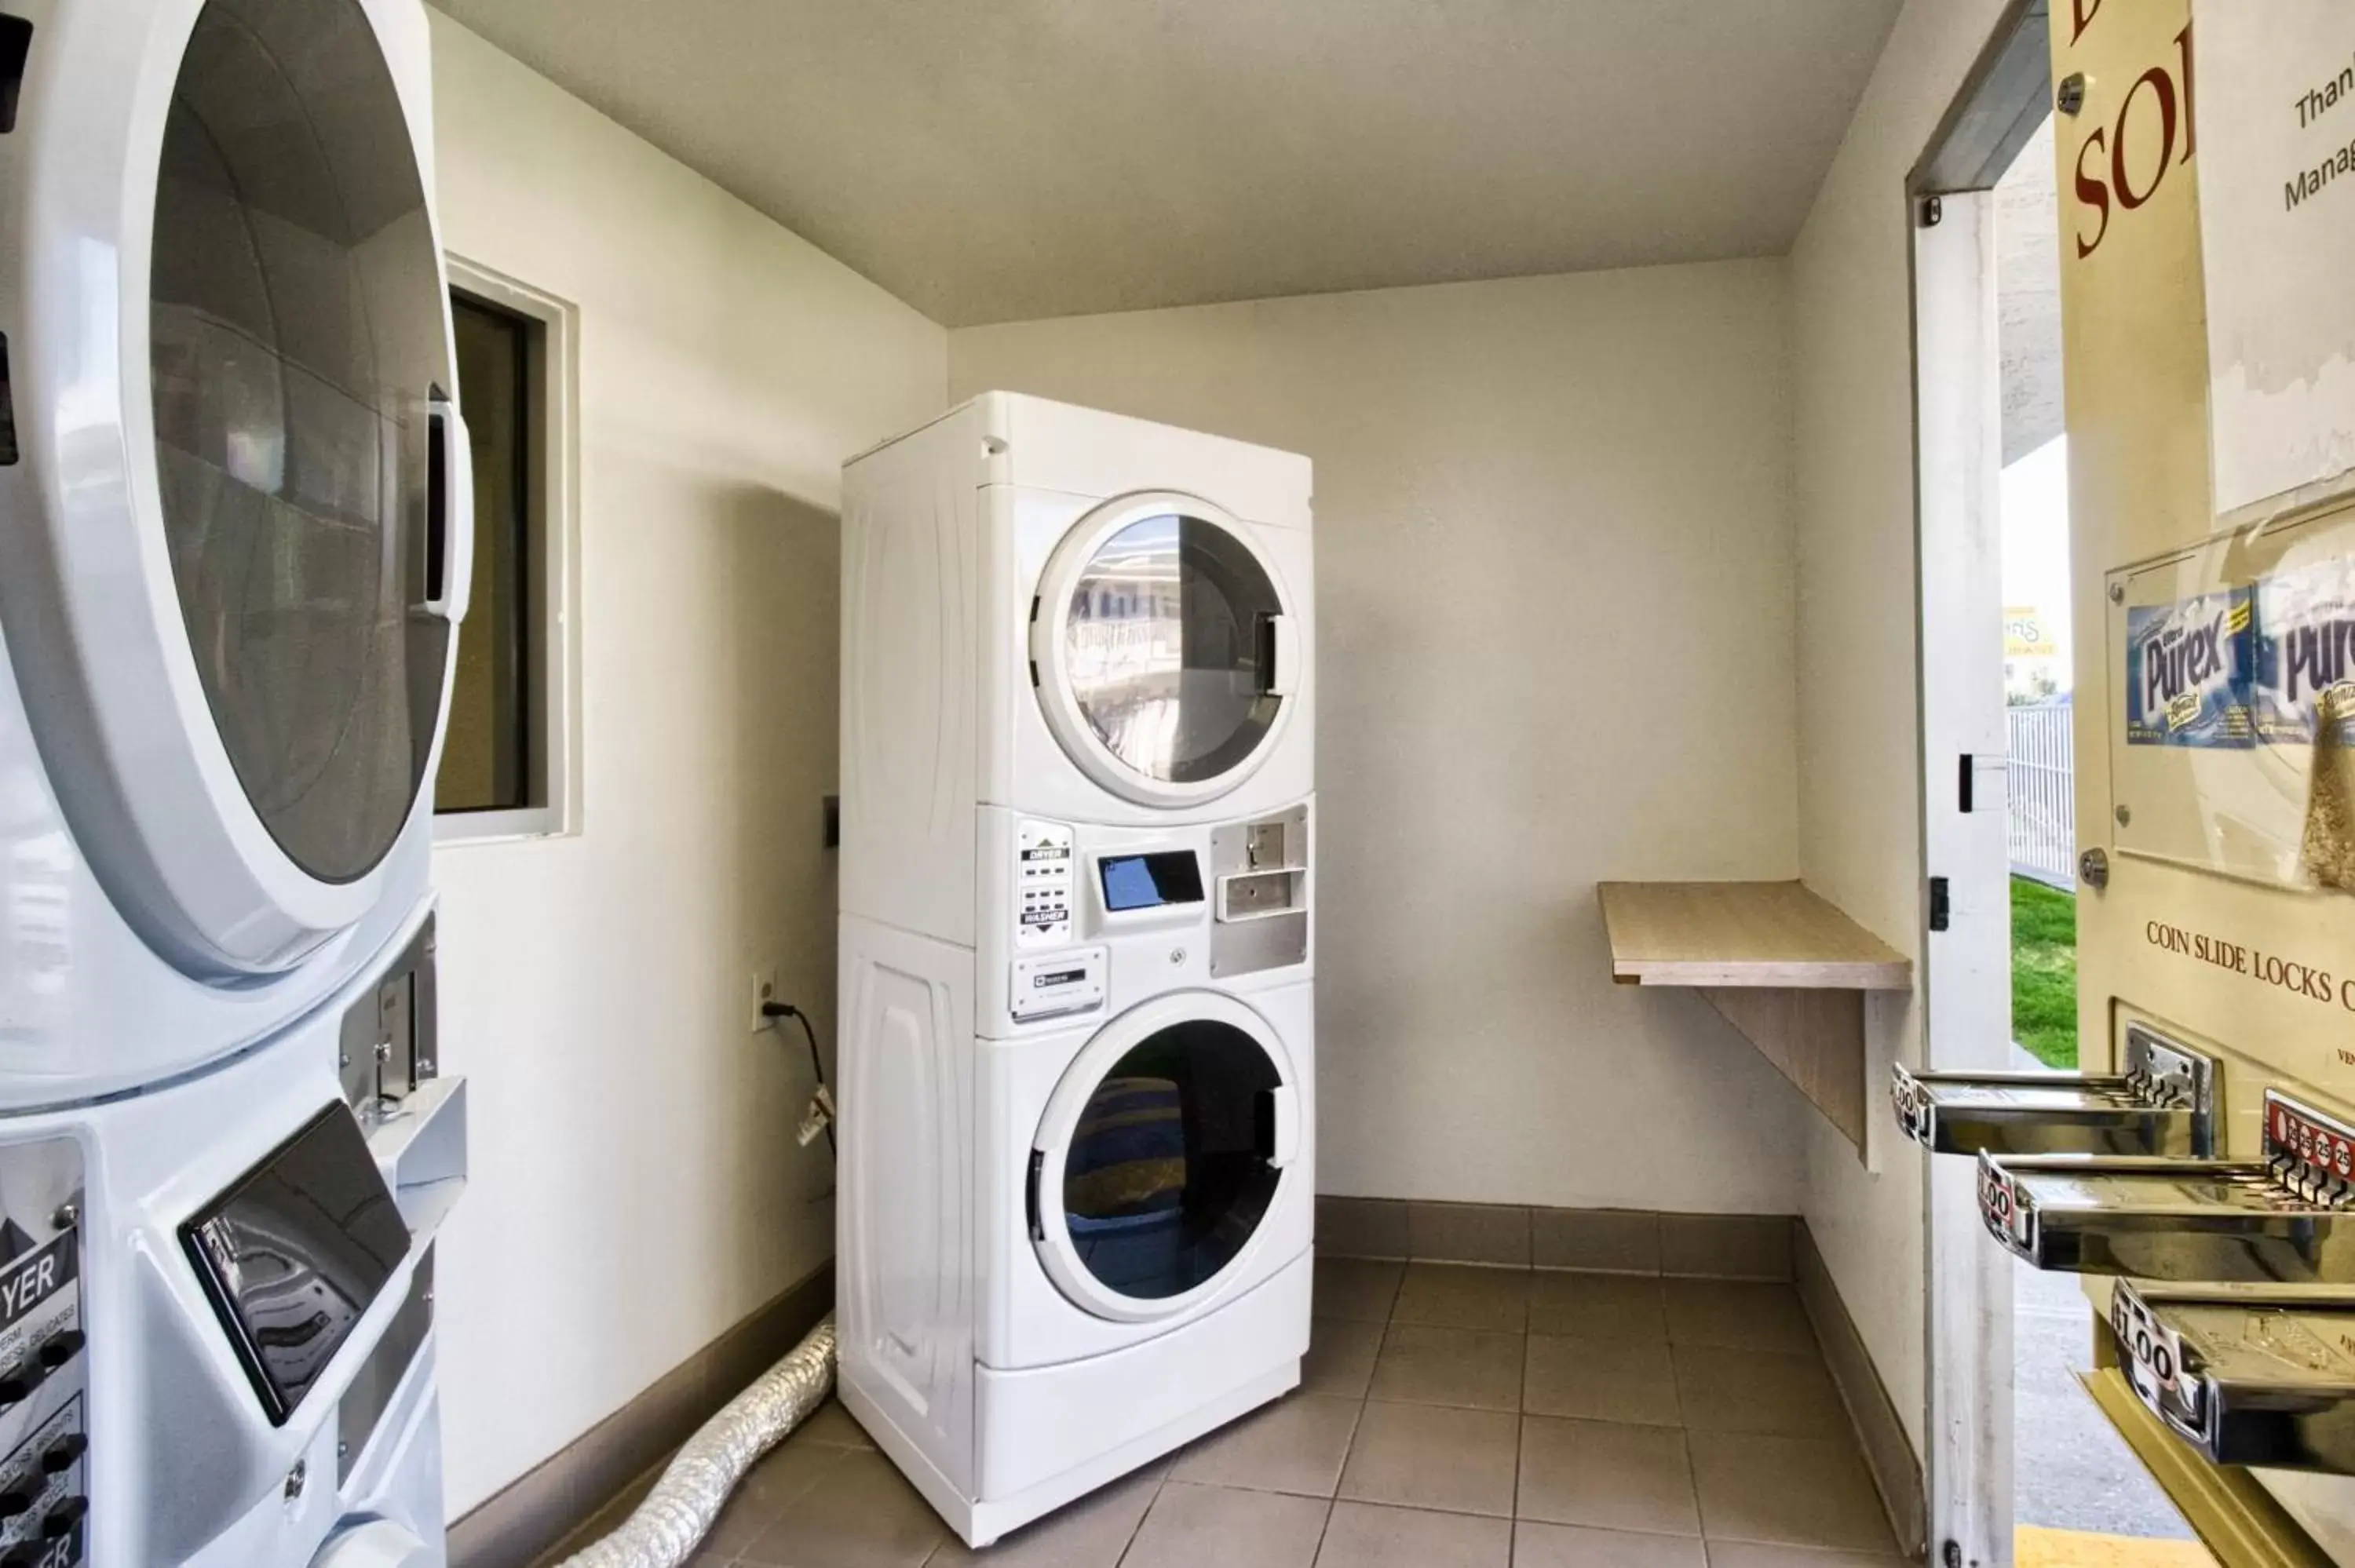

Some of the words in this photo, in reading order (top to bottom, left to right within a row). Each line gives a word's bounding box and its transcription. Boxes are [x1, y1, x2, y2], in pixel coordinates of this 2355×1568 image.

[2295, 53, 2355, 129] Than
[2147, 610, 2223, 712] Purex
[2286, 619, 2355, 702] Pur
[2146, 921, 2190, 955] COIN
[2194, 933, 2247, 974] SLIDE
[2254, 951, 2332, 1003] LOCKS
[2317, 1140, 2330, 1158] 25
[2336, 1148, 2350, 1167] 25
[2115, 1302, 2172, 1380] $1.00
